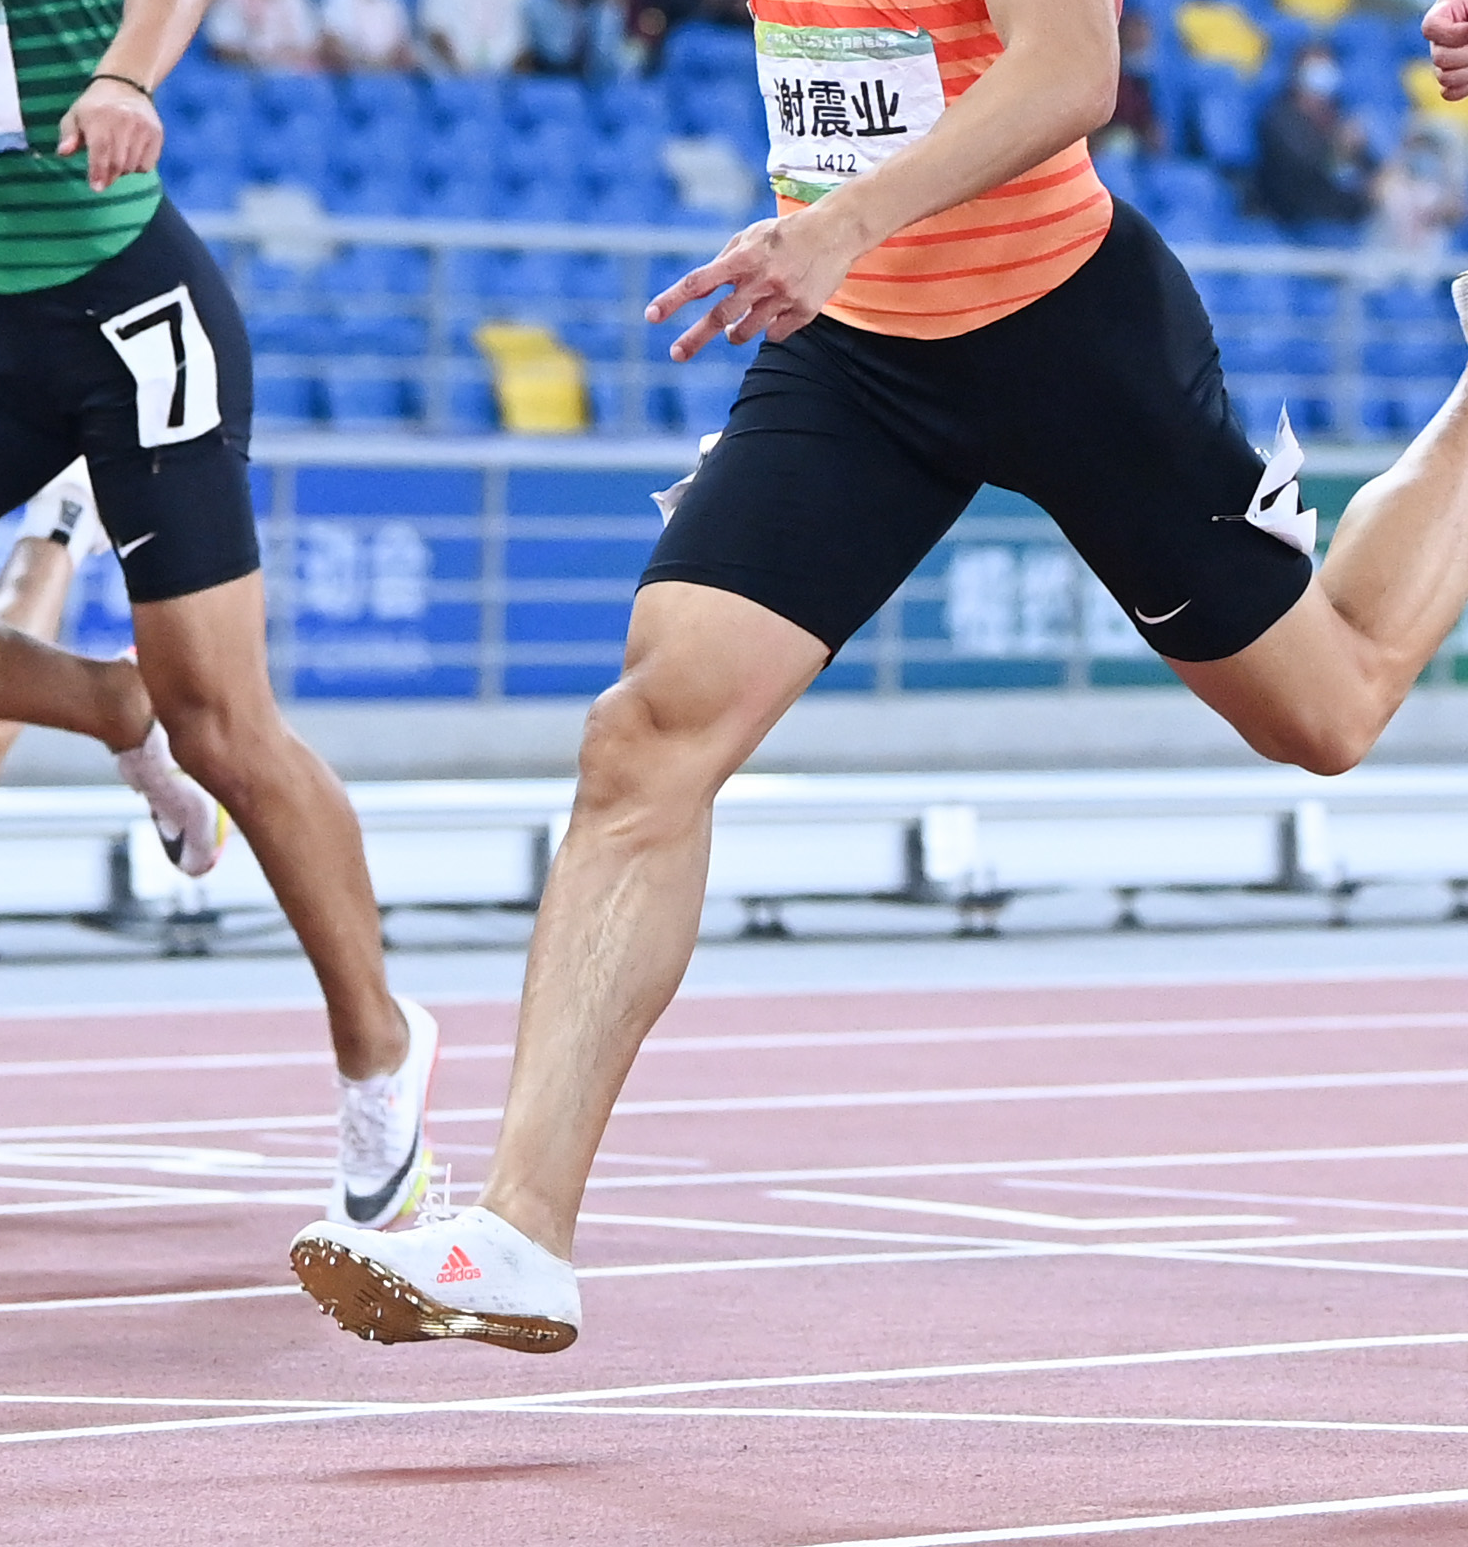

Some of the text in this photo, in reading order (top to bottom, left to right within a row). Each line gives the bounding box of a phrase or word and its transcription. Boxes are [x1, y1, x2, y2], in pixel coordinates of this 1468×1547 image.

[815, 153, 857, 173] 1412
[115, 301, 185, 429] 7
[436, 1266, 482, 1284] adidas
